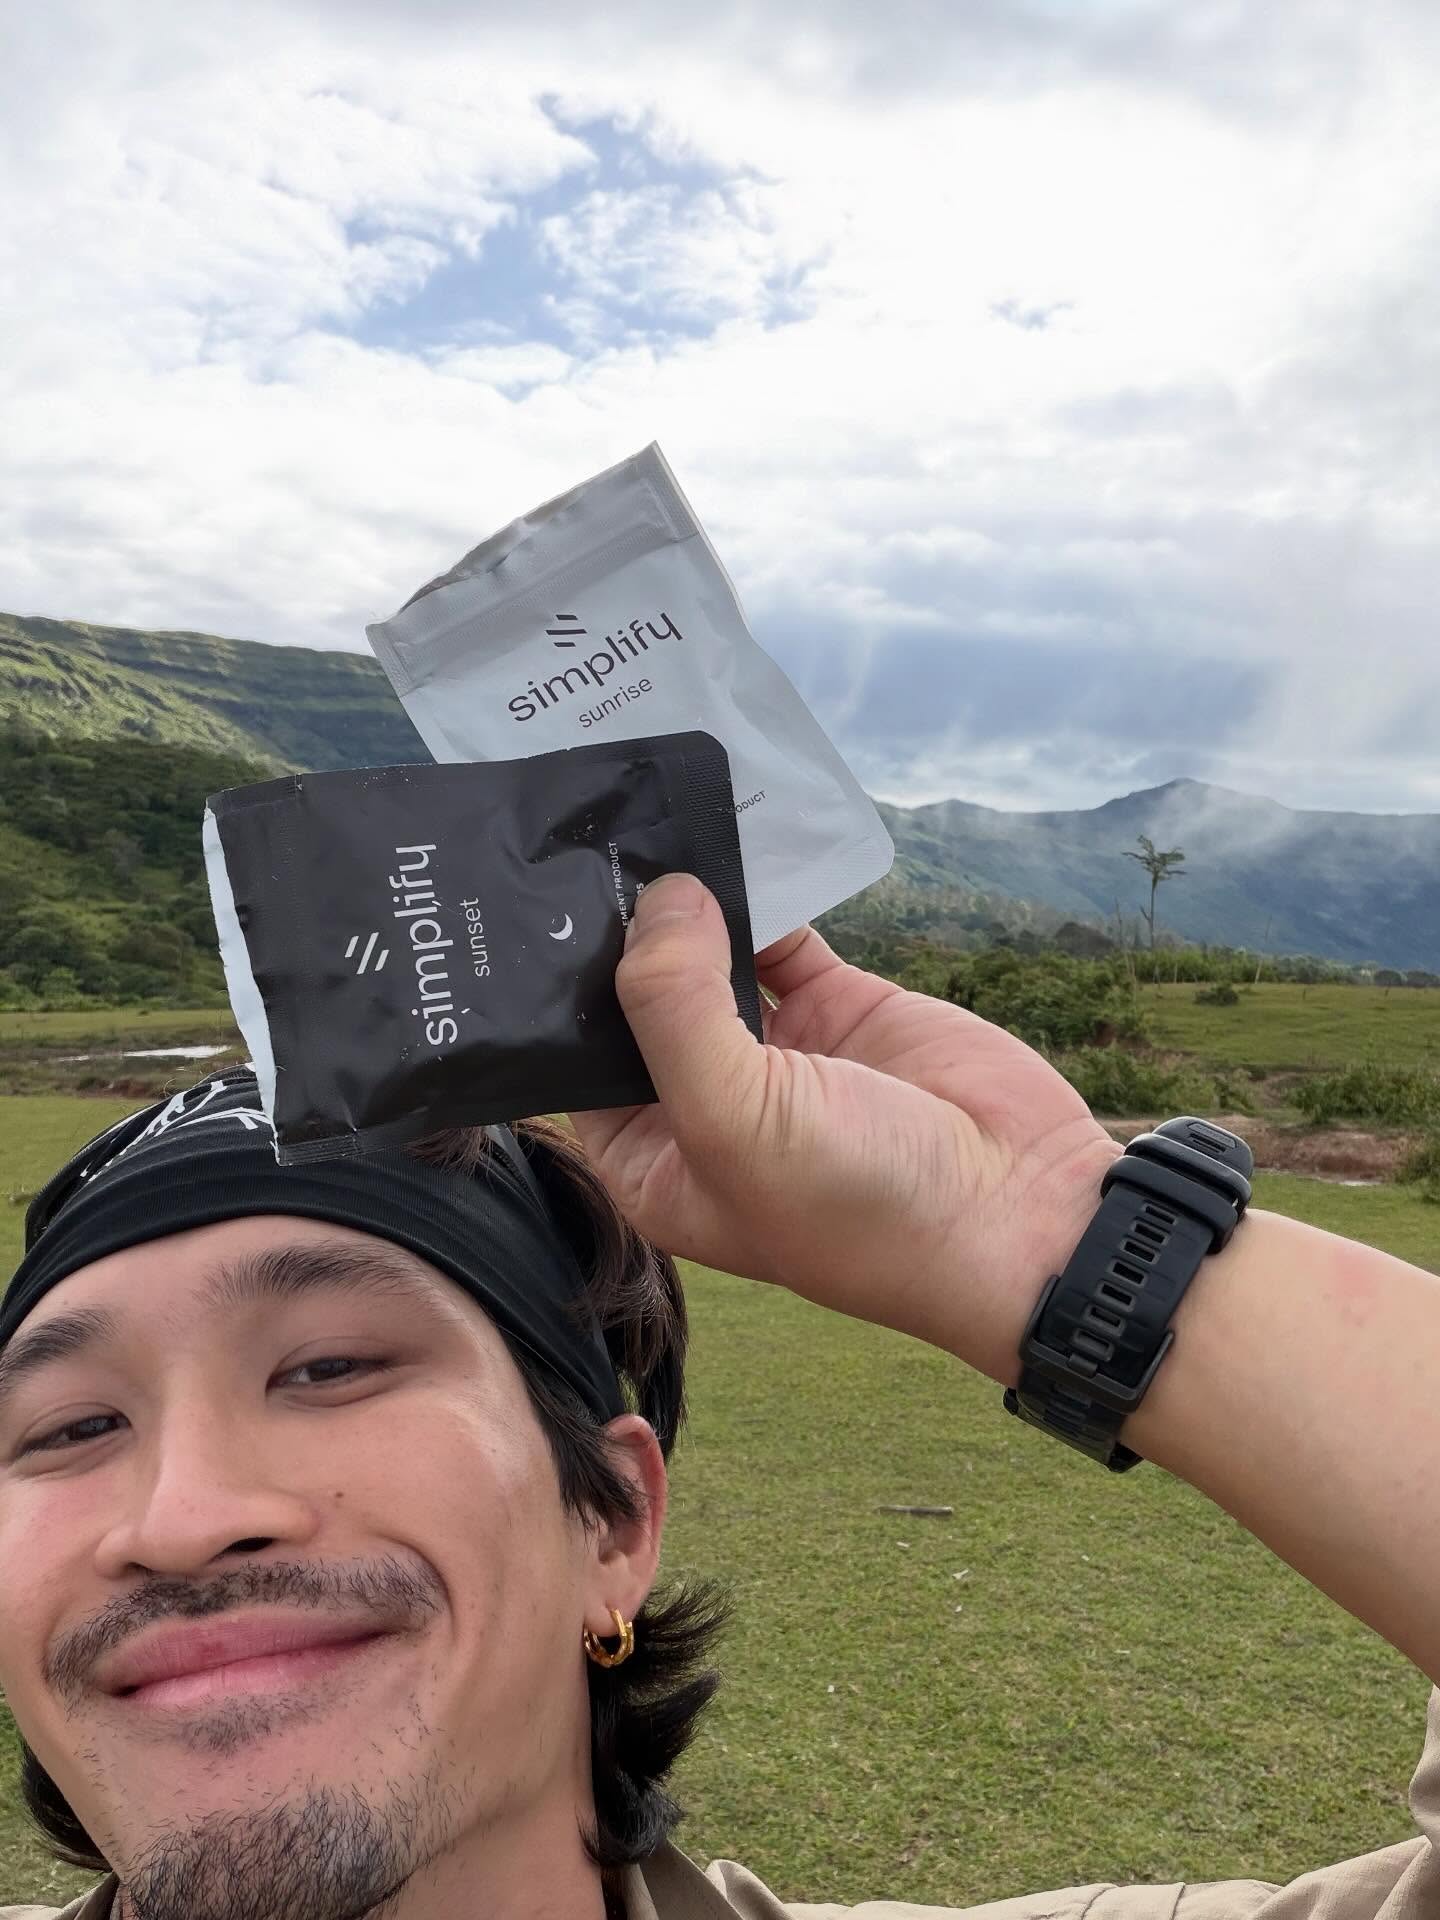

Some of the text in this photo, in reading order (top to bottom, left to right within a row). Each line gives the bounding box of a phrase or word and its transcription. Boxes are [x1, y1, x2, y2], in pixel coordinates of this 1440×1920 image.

[507, 612, 683, 722] simplify
[578, 678, 653, 728] sunrise
[735, 790, 766, 812] ODUCT
[608, 841, 629, 927] EMENT PRODUCT
[388, 844, 458, 1046] simplify
[459, 897, 490, 978] sunset
